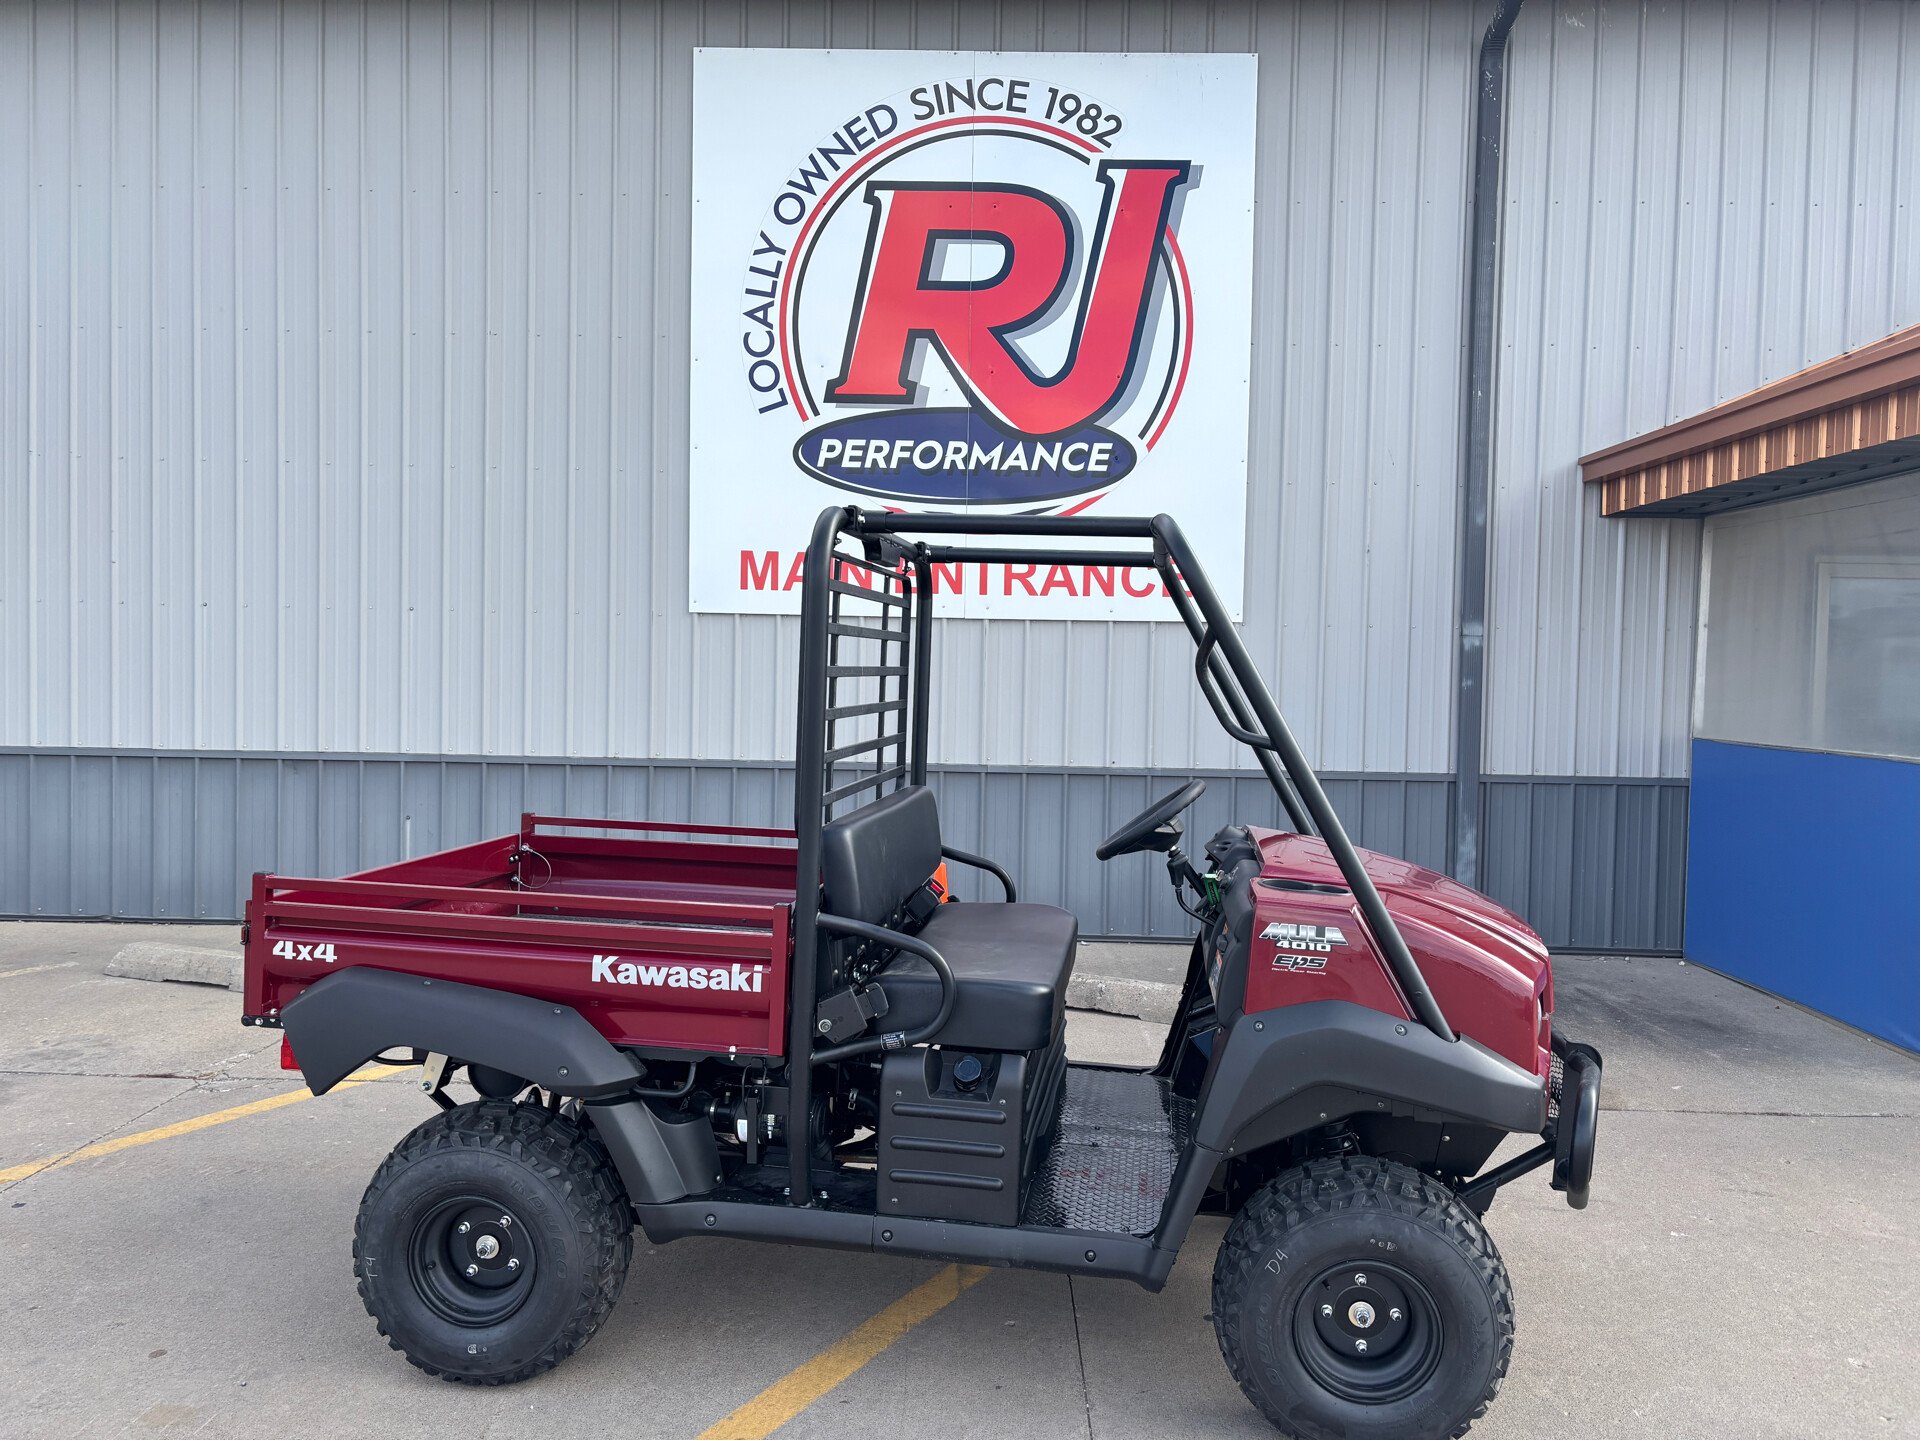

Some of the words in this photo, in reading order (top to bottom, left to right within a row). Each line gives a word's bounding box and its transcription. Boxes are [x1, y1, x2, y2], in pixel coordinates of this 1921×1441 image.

[742, 231, 788, 414] LOCALLY
[773, 103, 898, 226] OWNED
[909, 77, 1030, 121] SINCE
[1045, 86, 1123, 149] 1982
[824, 160, 1193, 438] RJ
[816, 438, 1115, 473] PERFORMANCE
[1259, 922, 1349, 946] MULE
[1276, 940, 1331, 952] 4010
[271, 940, 338, 964] 4x4
[591, 954, 764, 993] Kawasaki
[1264, 1248, 1289, 1275] D4
